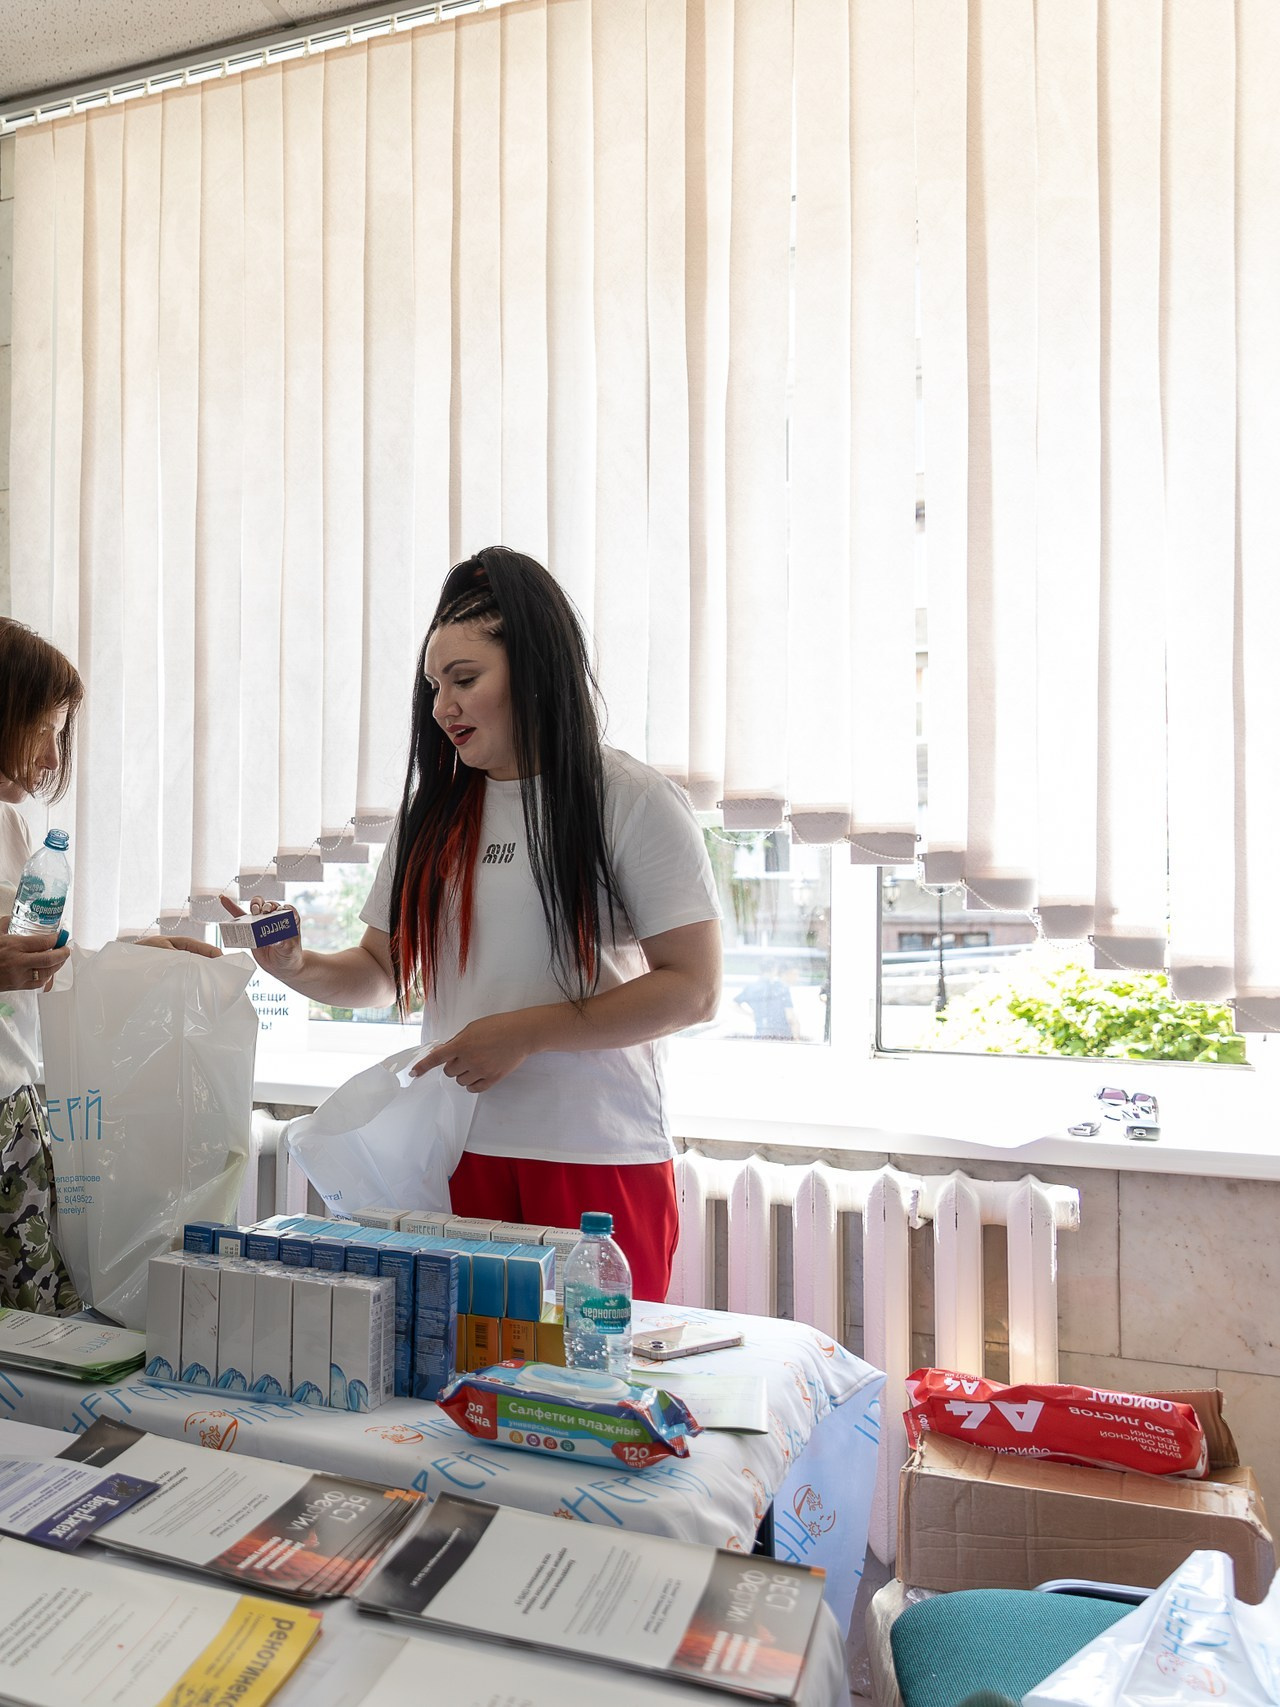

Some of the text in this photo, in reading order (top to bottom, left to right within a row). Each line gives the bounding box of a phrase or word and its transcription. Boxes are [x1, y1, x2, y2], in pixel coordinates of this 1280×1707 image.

[252, 993, 286, 1003] ВЕЩИ
[944, 1379, 980, 1395] А4
[508, 1402, 642, 1437] Салфетки влажные
[945, 1399, 1045, 1433] А4
[1069, 1406, 1176, 1436] 500 ЛИСТОВ
[1099, 1430, 1181, 1452] ДЛЯ ОФИСНОЙ
[1129, 1429, 1179, 1445] ТЕХНИКИ
[622, 1446, 650, 1461] 120
[1139, 1445, 1182, 1459] БУМАГА
[288, 1491, 344, 1533] Фертил
[330, 1494, 372, 1524] БЕСТ
[726, 1570, 767, 1624] Фертил
